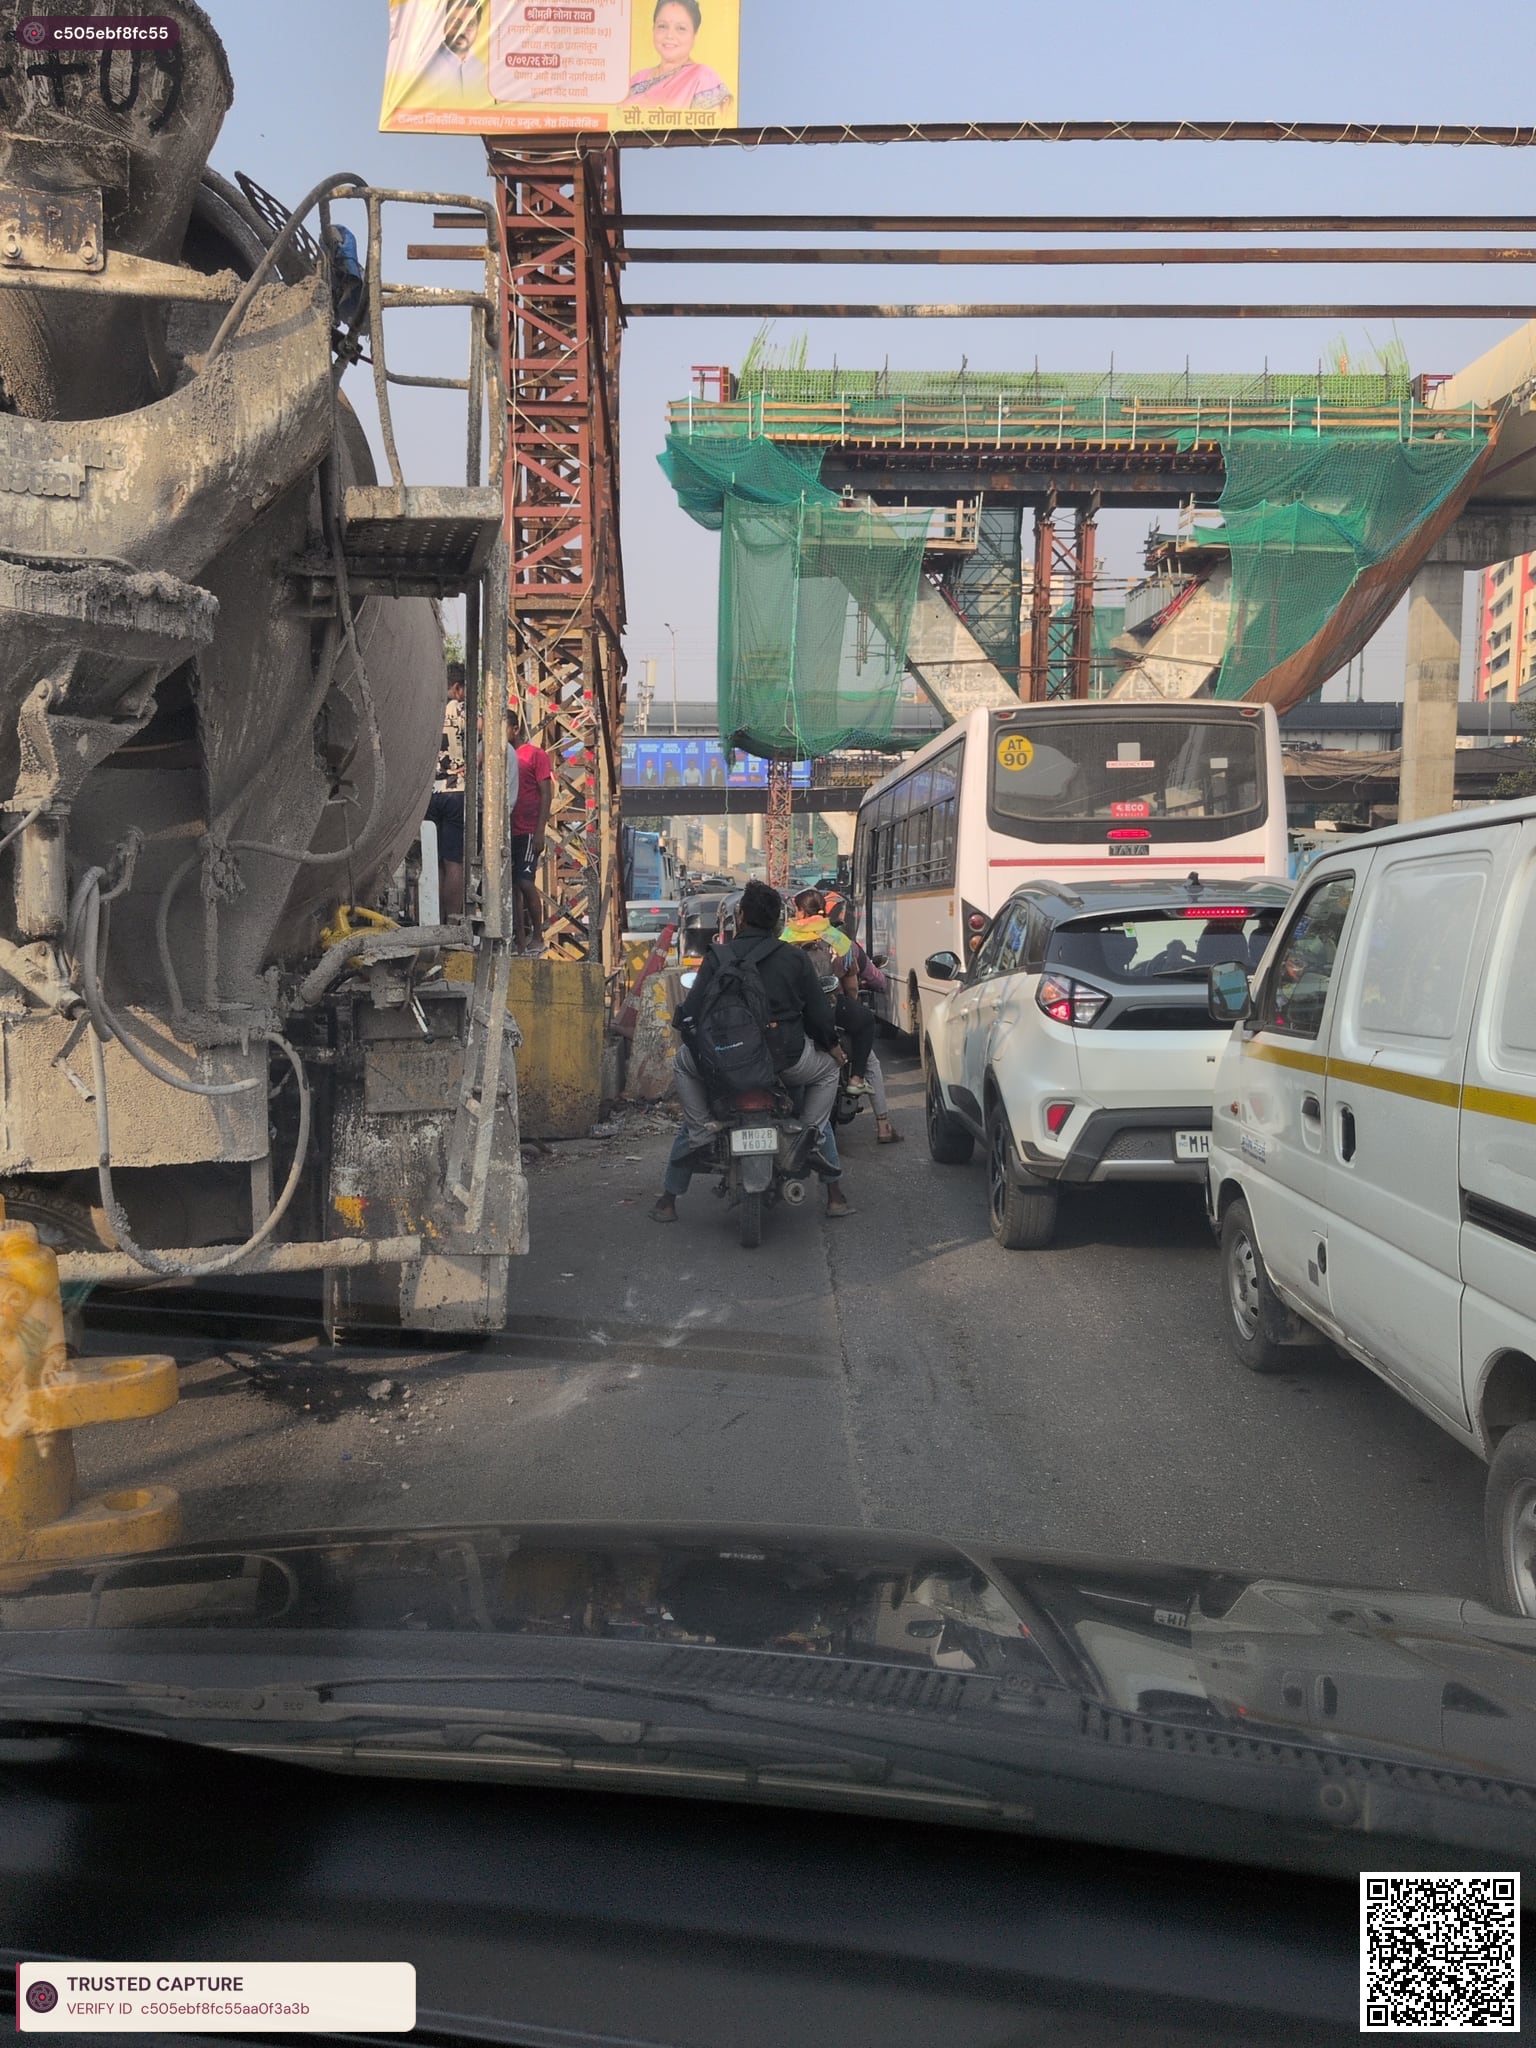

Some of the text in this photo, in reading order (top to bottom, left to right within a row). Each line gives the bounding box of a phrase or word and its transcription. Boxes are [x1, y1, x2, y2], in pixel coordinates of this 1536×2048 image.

[527, 7, 592, 21] श्रीमती लोना रावत
[541, 54, 558, 67] रोजी
[623, 106, 717, 126] सौ. लोना रावत
[1007, 739, 1023, 751] AT
[1003, 753, 1028, 766] 90
[1111, 845, 1147, 855] TATA
[1189, 1135, 1209, 1152] MH
